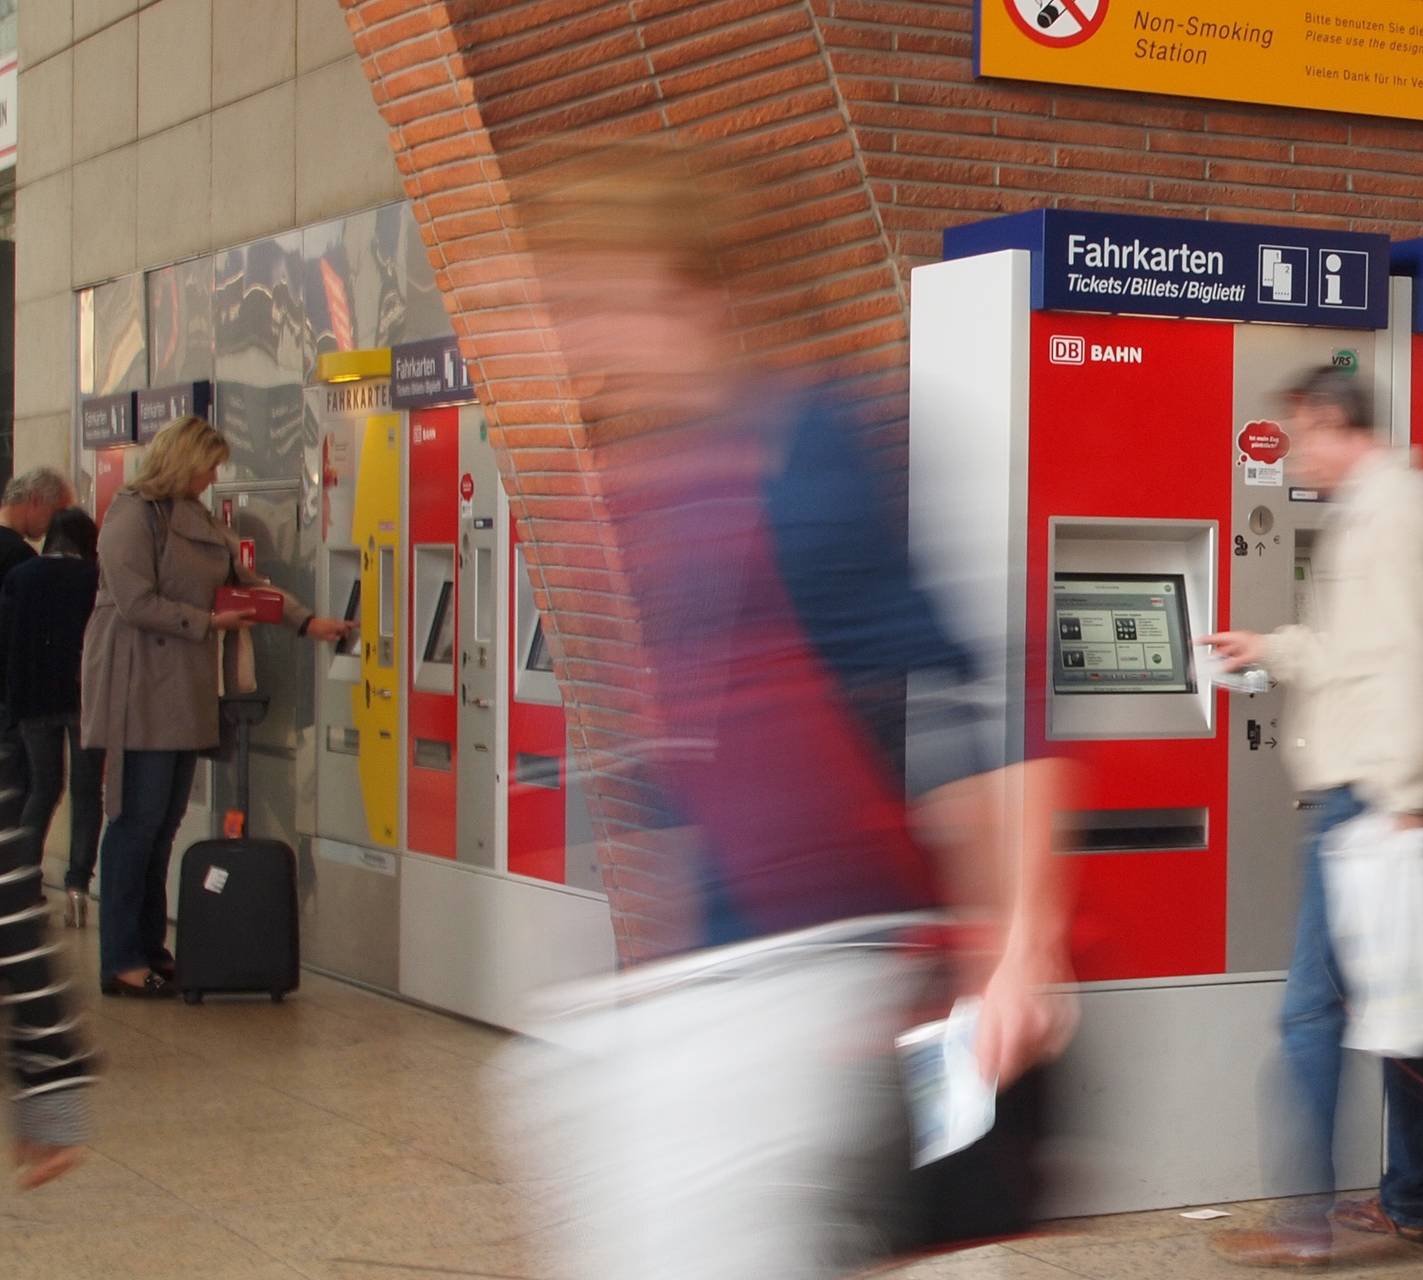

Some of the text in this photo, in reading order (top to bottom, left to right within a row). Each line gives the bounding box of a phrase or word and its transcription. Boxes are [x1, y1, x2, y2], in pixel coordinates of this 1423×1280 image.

[1134, 10, 1274, 48] Non-Smoking
[1304, 12, 1331, 26] Bitte
[1335, 15, 1384, 32] benutzen
[1388, 22, 1405, 34] Sie
[1134, 38, 1207, 65] Station
[1306, 31, 1342, 45] Please
[1346, 37, 1364, 48] use
[1368, 38, 1386, 50] the
[1305, 65, 1340, 79] Vielen
[1344, 69, 1370, 83] Dank
[1374, 72, 1389, 84] für
[1393, 75, 1408, 87] Ihr
[1067, 234, 1224, 276] Fahrkarten
[1055, 341, 1142, 364] DB BAHN
[1332, 355, 1352, 366] VRS
